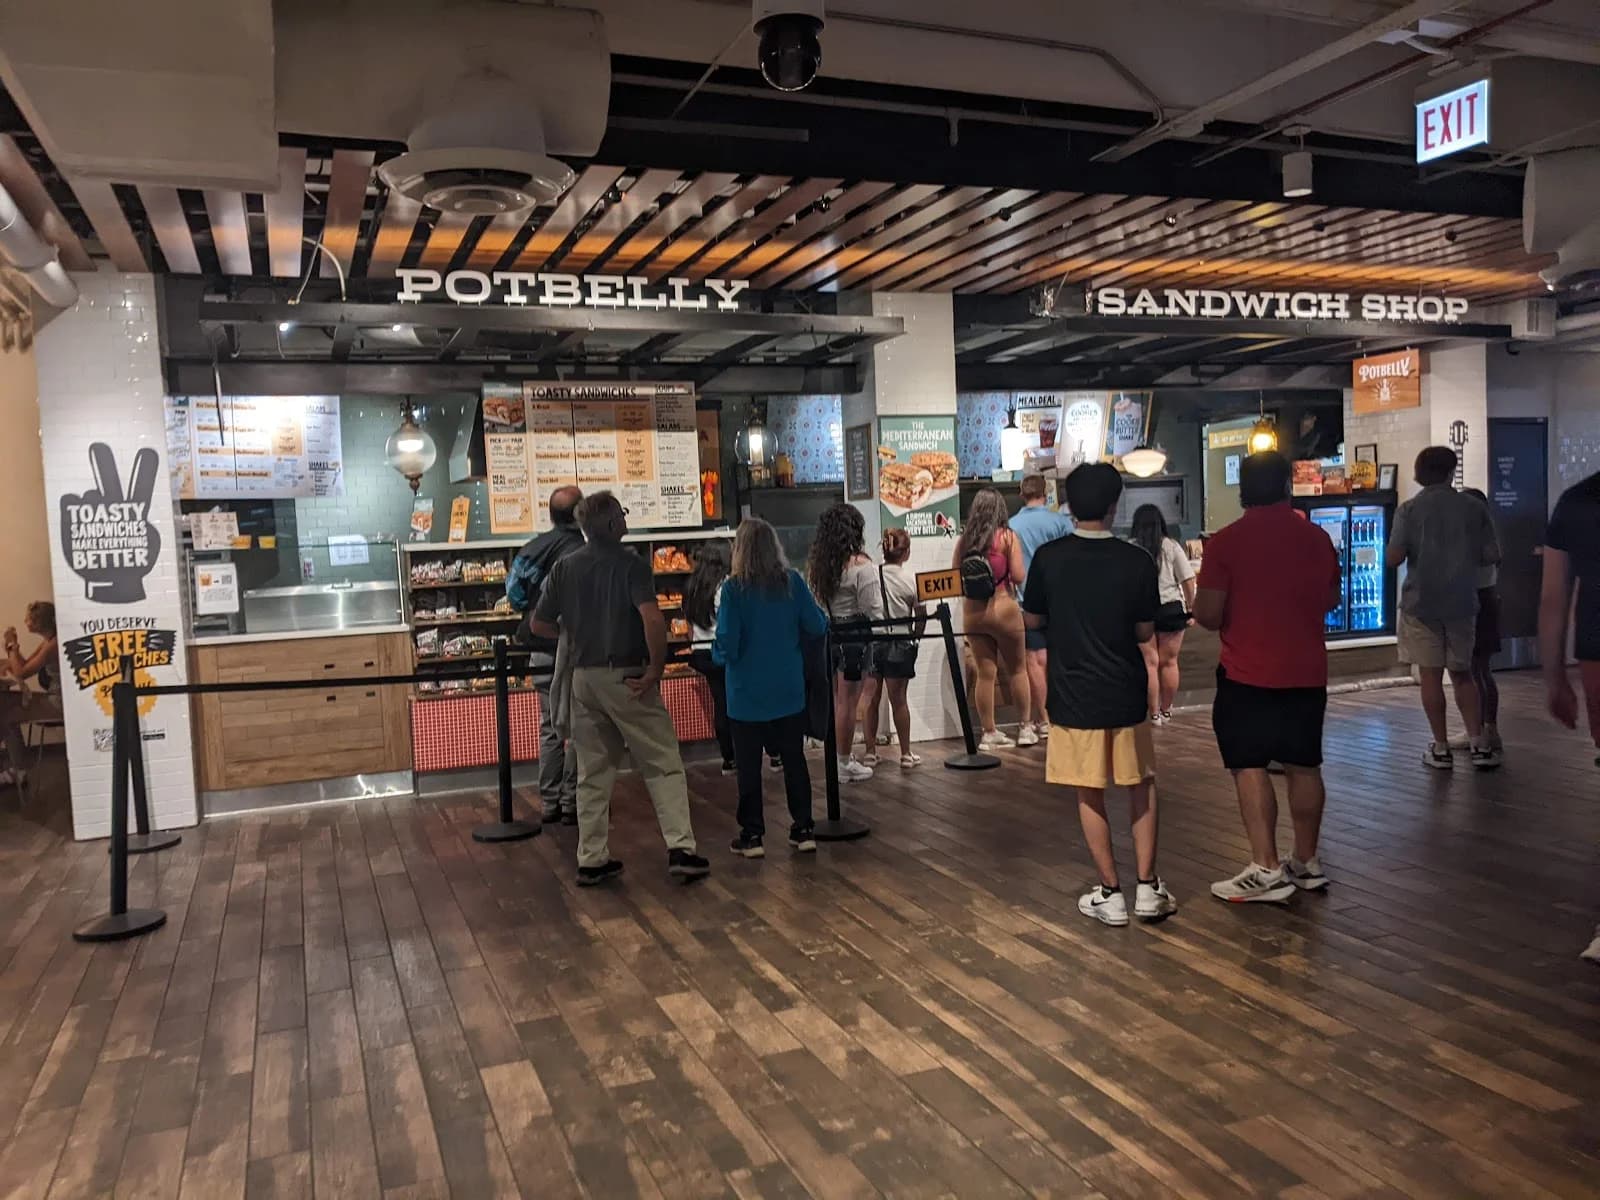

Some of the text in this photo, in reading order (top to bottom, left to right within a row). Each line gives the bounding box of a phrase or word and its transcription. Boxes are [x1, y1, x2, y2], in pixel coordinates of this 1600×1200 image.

[1424, 92, 1478, 151] EXIT
[395, 268, 750, 310] POTBELLY
[1097, 287, 1468, 322] SANDWICH SHOP
[1358, 356, 1410, 384] POTBELLY
[532, 387, 637, 398] TOASTY SANDWICHES
[1018, 394, 1056, 407] MEAL DEAL
[882, 430, 953, 441] MEDITERRANEAN
[898, 440, 938, 450] SANDWICH
[308, 461, 329, 469] SHAKES
[67, 502, 146, 524] TOASTY
[70, 521, 147, 539] SANDWICHES
[72, 536, 148, 550] MAKE EVERYTHING
[72, 548, 149, 570] BETTER
[924, 576, 953, 593] EXIT
[80, 616, 157, 634] YOU DESERVE
[92, 630, 148, 661] FREE
[79, 650, 169, 687] SANDCHES
